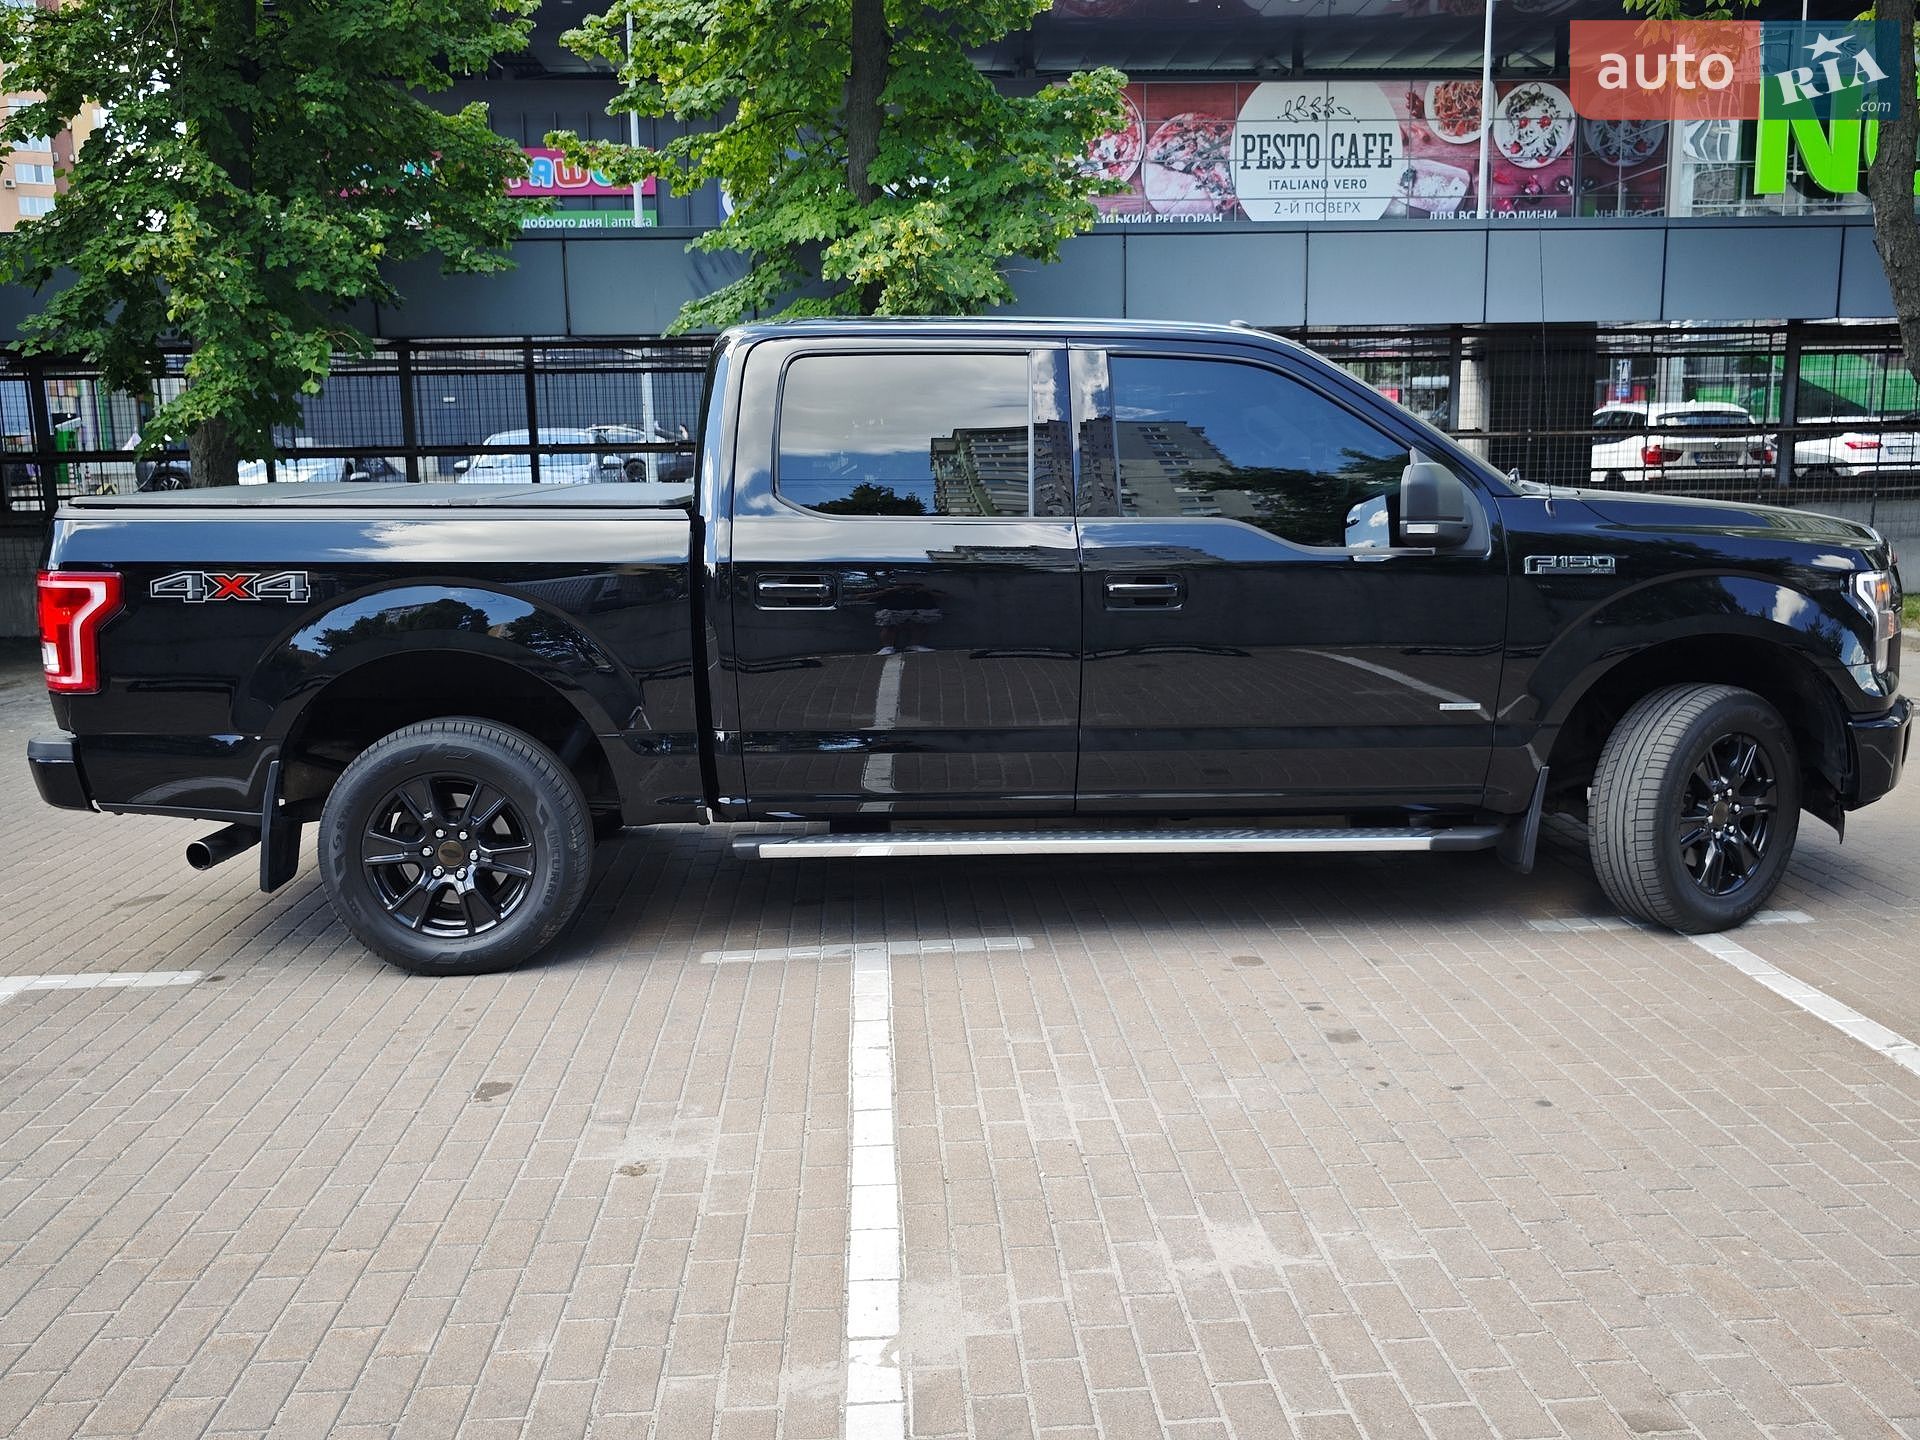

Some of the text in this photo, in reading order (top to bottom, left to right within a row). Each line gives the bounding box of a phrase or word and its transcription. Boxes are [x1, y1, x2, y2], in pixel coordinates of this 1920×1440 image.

[1240, 133, 1393, 170] PESTO CAFE
[1268, 179, 1368, 191] ITALIANO VERO
[1274, 201, 1361, 215] 2-Й ПОВЕРХ
[522, 217, 577, 229] доброго
[579, 218, 603, 229] дня
